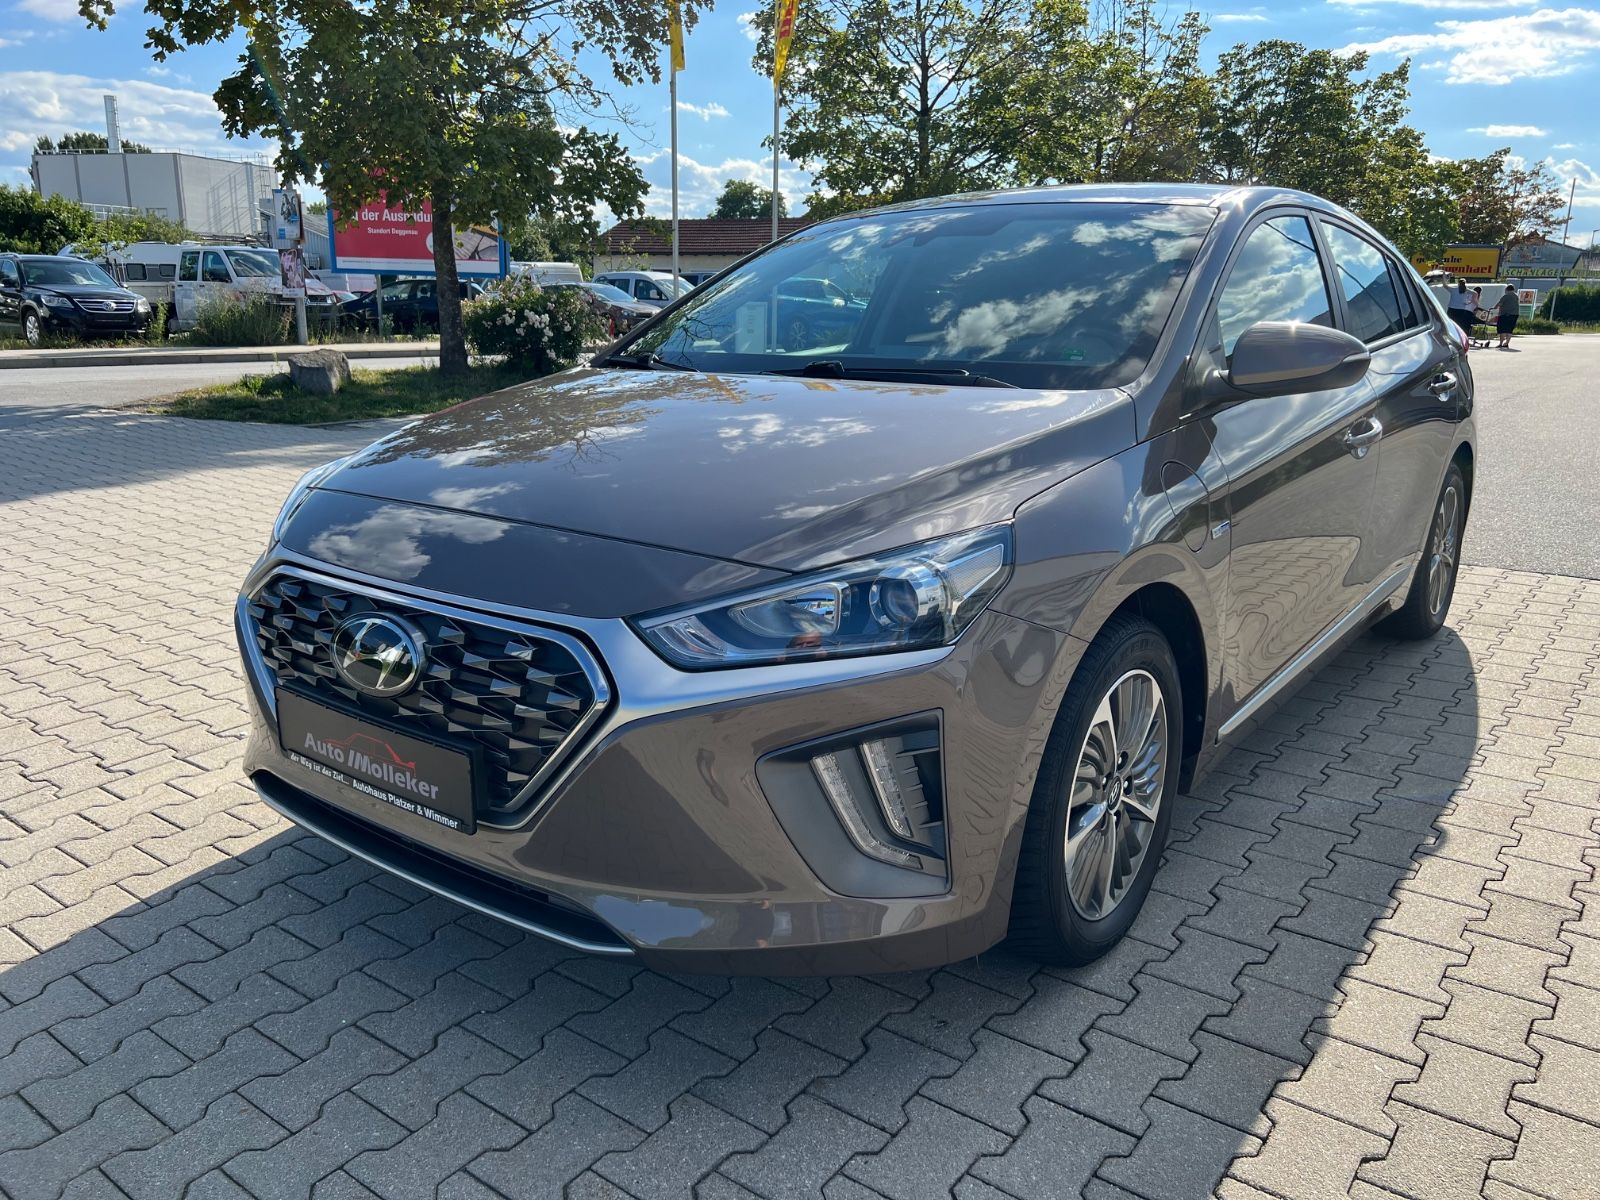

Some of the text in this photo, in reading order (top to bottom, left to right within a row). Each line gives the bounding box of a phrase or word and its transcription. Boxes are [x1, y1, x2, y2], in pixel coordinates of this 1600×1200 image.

[361, 208, 379, 221] der
[367, 227, 390, 235] Standort
[304, 732, 345, 763] Auto
[352, 779, 387, 801] Autohaus
[388, 793, 415, 812] Platzer
[416, 805, 423, 815] &
[424, 806, 458, 829] Wimmer
